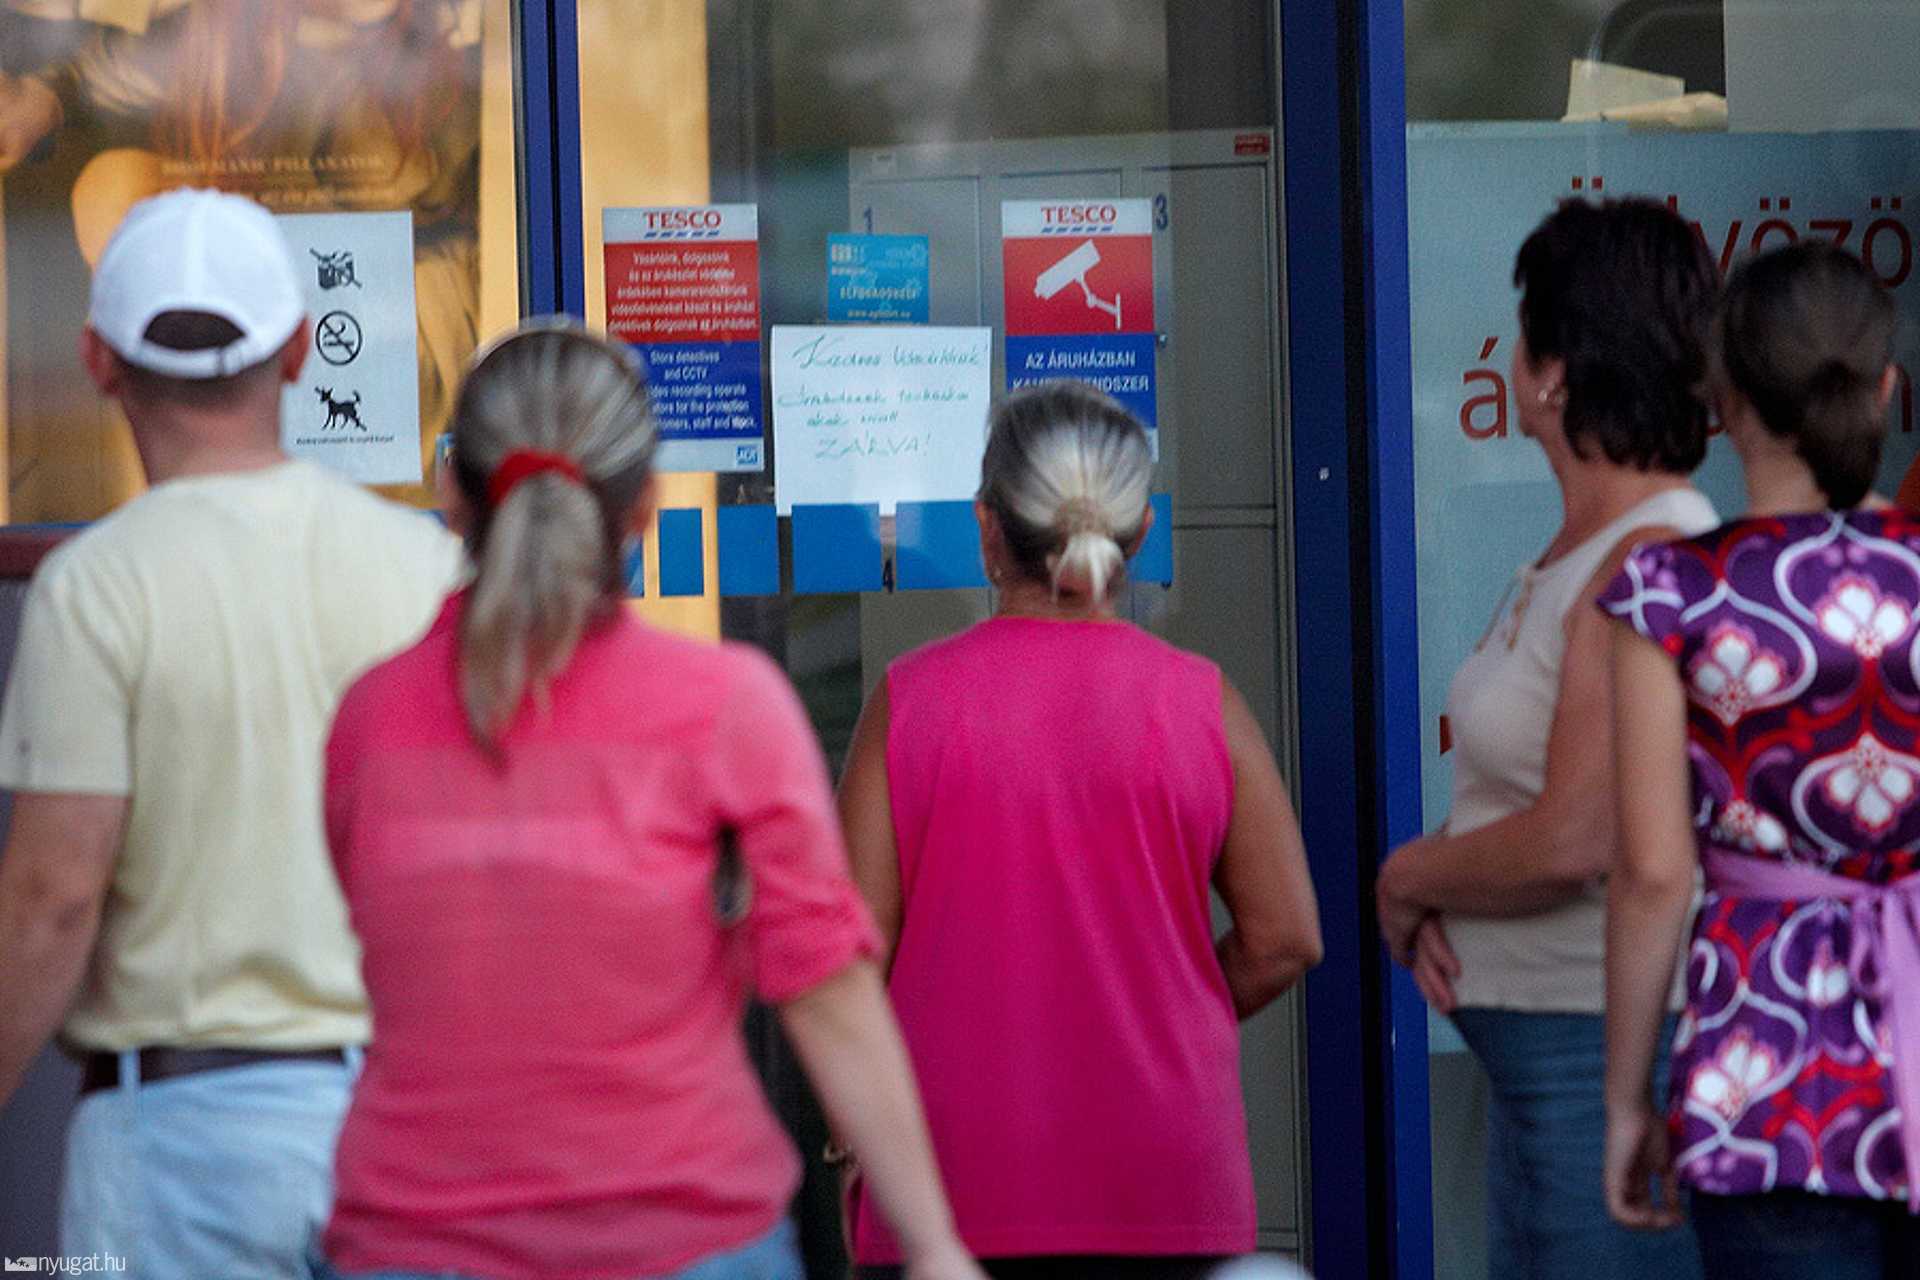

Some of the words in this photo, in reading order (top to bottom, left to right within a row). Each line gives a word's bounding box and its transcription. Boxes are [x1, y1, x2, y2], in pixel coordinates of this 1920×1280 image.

[643, 210, 721, 229] TESCO
[1041, 204, 1116, 224] TESCO
[1155, 193, 1168, 230] 3
[1025, 352, 1045, 369] AZ
[1047, 348, 1136, 369] ÁRUHÁZBAN
